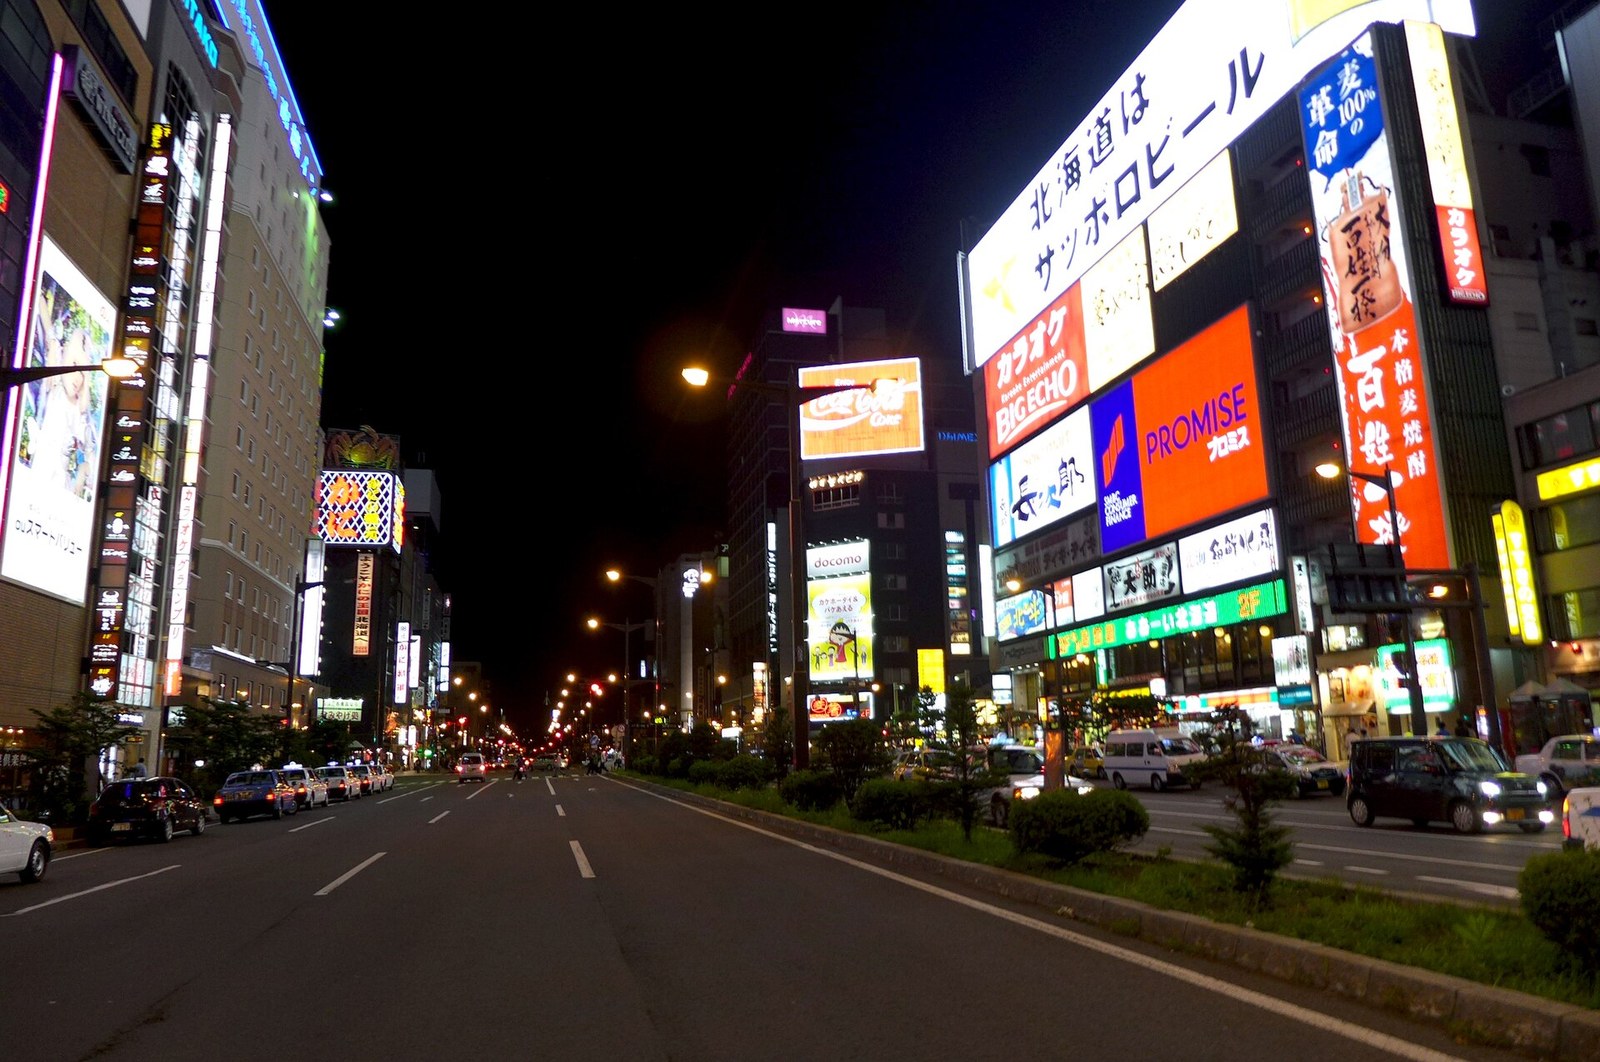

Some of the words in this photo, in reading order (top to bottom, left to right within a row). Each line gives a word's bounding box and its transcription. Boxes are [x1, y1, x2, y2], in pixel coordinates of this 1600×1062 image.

[1030, 72, 1149, 231] 北海道は
[1306, 85, 1336, 169] 革命
[1034, 48, 1265, 292] サッポロビール
[1448, 209, 1475, 287] カラオケ
[997, 305, 1067, 389] カラオケ
[996, 395, 1027, 445] BIG
[1026, 359, 1077, 414] ECHO
[1146, 382, 1247, 465] PROMISE
[1390, 328, 1426, 479] 本格麦焼酎
[1206, 425, 1250, 464] プロミス
[328, 475, 360, 539] かに
[1105, 507, 1133, 527] FINANCE
[814, 555, 862, 569] docomo
[1238, 590, 1260, 618] 2F
